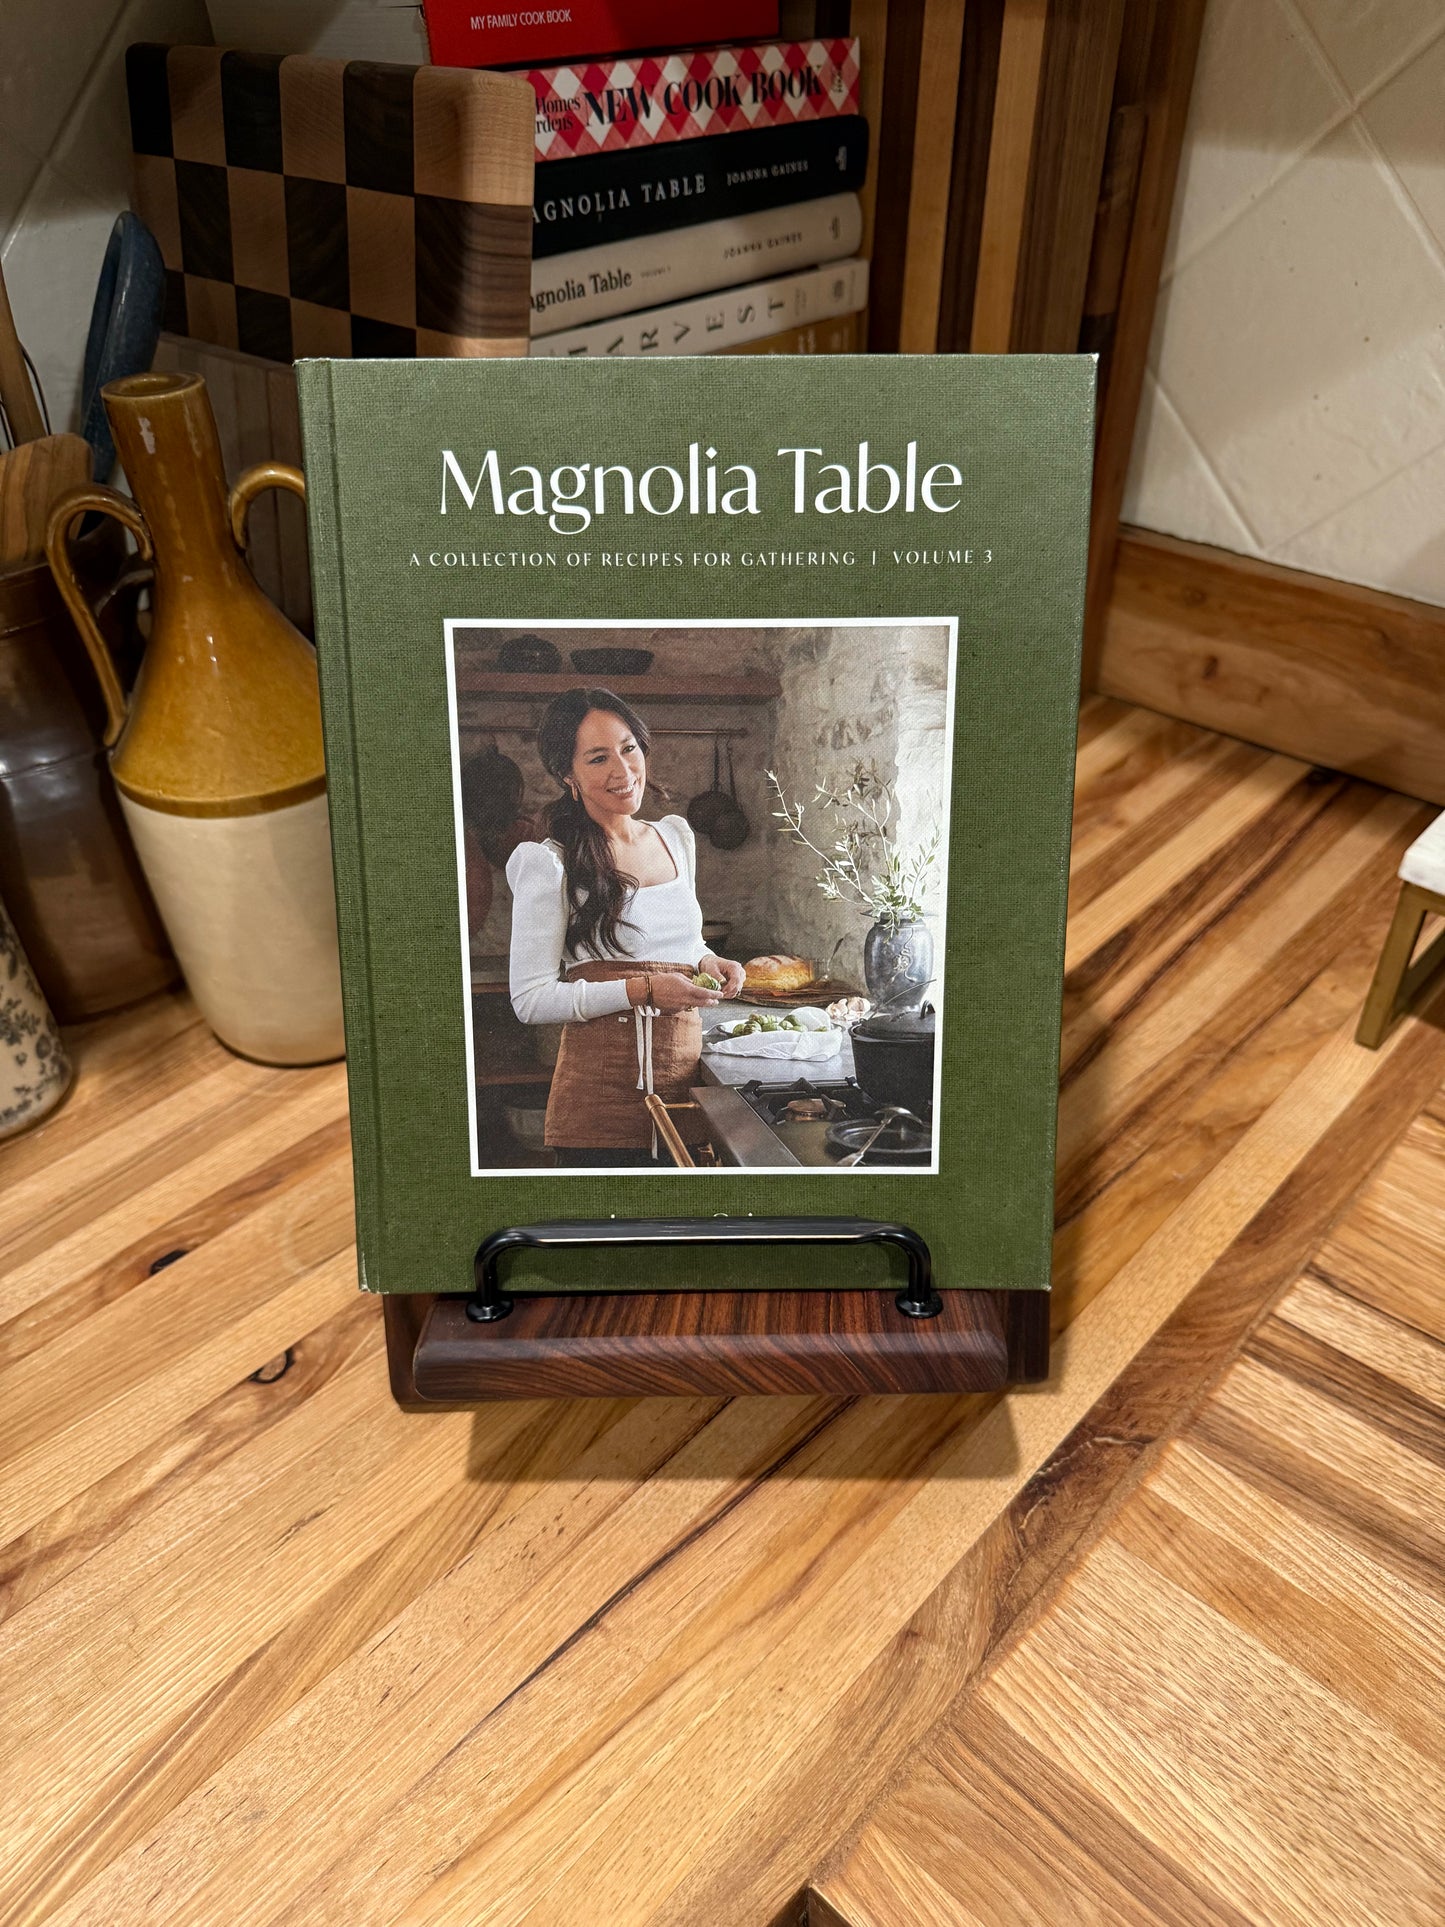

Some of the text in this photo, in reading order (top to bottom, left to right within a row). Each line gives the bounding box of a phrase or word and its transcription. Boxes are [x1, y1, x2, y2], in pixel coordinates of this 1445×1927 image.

[470, 8, 572, 30] MY FAMILY COOK BOOK
[535, 96, 581, 115] Homes
[584, 86, 655, 128] NEW
[663, 73, 743, 116] COOK
[751, 65, 822, 104] BOOK
[535, 114, 573, 134] rdens
[726, 159, 809, 187] JOANNA GAINES
[532, 173, 706, 224] AGNOLIA TABLE
[530, 267, 633, 313] gnolia Table
[440, 440, 964, 536] Magnolia Table
[408, 552, 421, 567] A
[428, 552, 557, 568] COLLECTION
[566, 551, 593, 567] OF
[601, 551, 684, 567] RECIPES
[692, 551, 733, 567] FOR
[740, 550, 856, 566] GATHERING
[893, 549, 974, 564] VOLUME
[983, 549, 993, 564] 3
